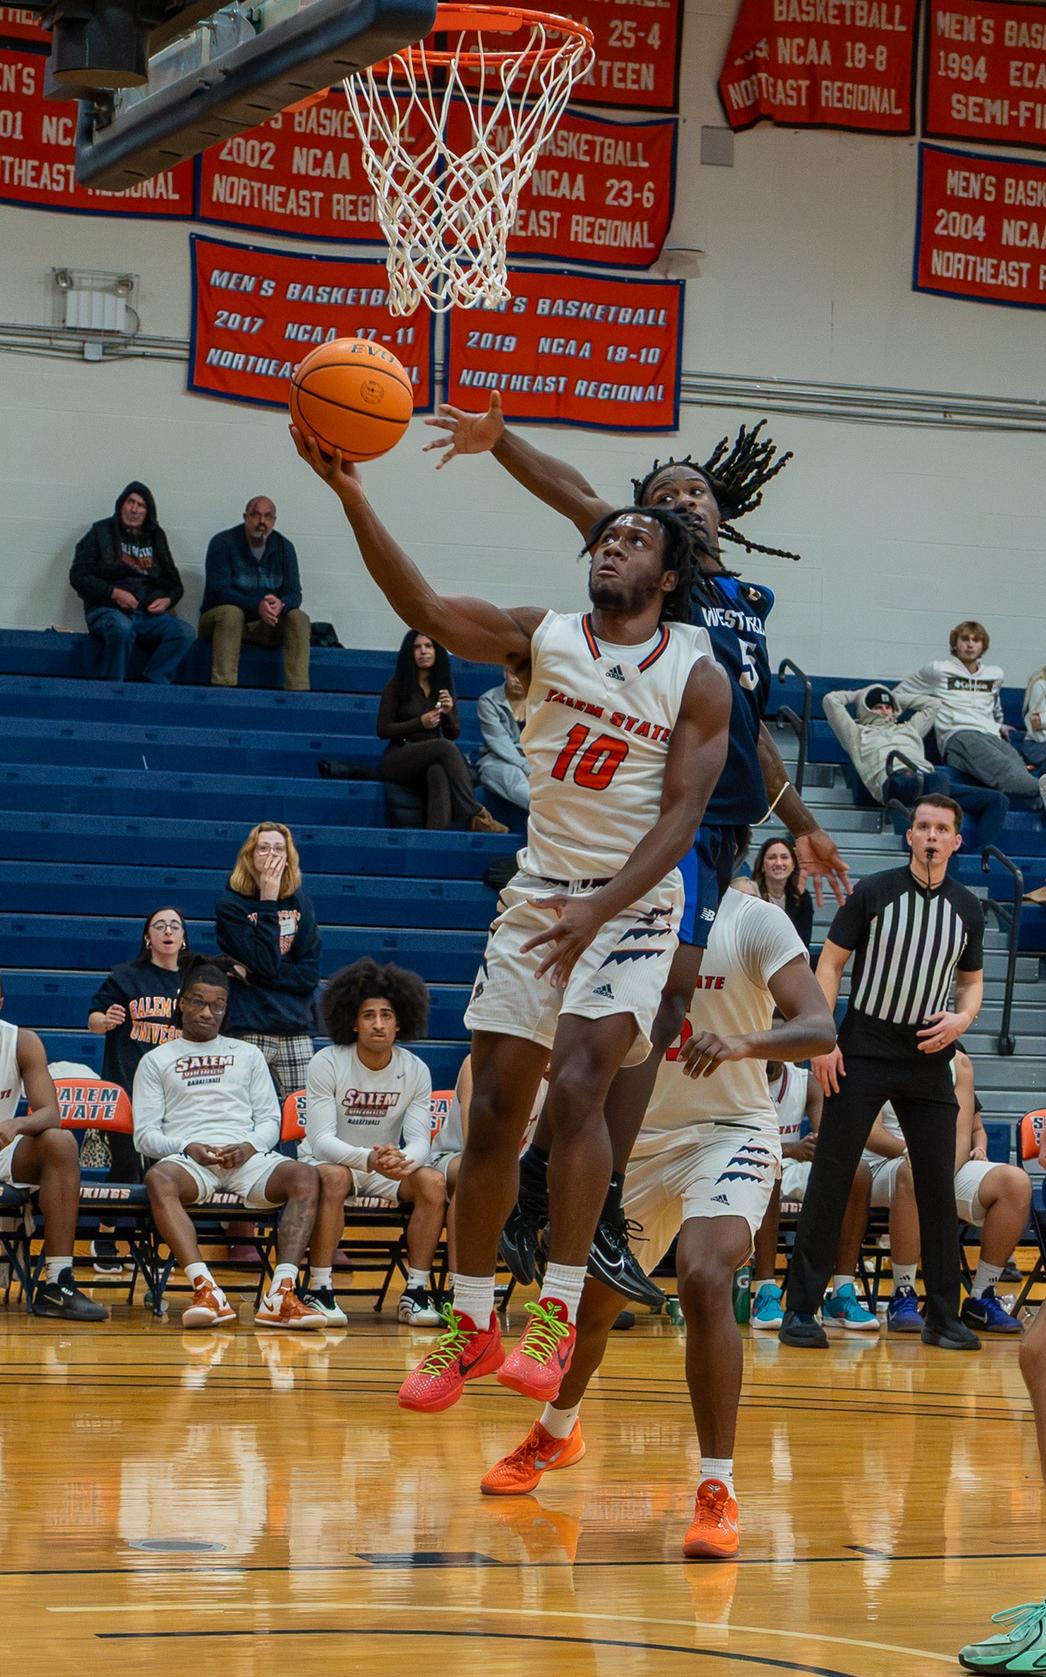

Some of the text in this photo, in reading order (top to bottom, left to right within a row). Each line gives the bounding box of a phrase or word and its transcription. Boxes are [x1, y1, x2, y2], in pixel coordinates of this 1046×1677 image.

[773, 0, 908, 32] BASKETBALL
[936, 10, 1046, 50] MEN'S BAS
[607, 19, 661, 50] 25-4
[776, 36, 832, 66] NCAA
[844, 41, 888, 72] 18-8
[937, 50, 988, 84] 1994
[820, 80, 903, 116] REGIONAL
[41, 115, 78, 147] NC
[219, 137, 276, 170] 2002
[291, 146, 352, 180] NCAA
[211, 173, 324, 219] NORTHEAST
[531, 168, 586, 201] NCAA
[605, 178, 656, 209] 23-6
[946, 168, 997, 202] MEN'S
[570, 214, 656, 249] REGIONAL
[934, 208, 987, 242] 2004
[931, 248, 1032, 289] NORTHEAST
[209, 269, 418, 309] MEN'S BASKETB
[213, 310, 265, 335] 2017
[283, 322, 337, 344] NCAA
[535, 297, 668, 327] BASKETBALL
[205, 347, 300, 380] NORTHEAS
[466, 330, 662, 365] 2019 NCAA 18-10
[459, 368, 665, 402] NORTHEAST REGIONAL
[738, 637, 761, 691] 5
[551, 722, 630, 791] 10
[696, 974, 726, 990] ATE
[175, 1054, 235, 1073] SALEM
[57, 1087, 121, 1103] ALEM
[60, 1103, 116, 1120] TATE
[341, 1088, 400, 1107] SALEM
